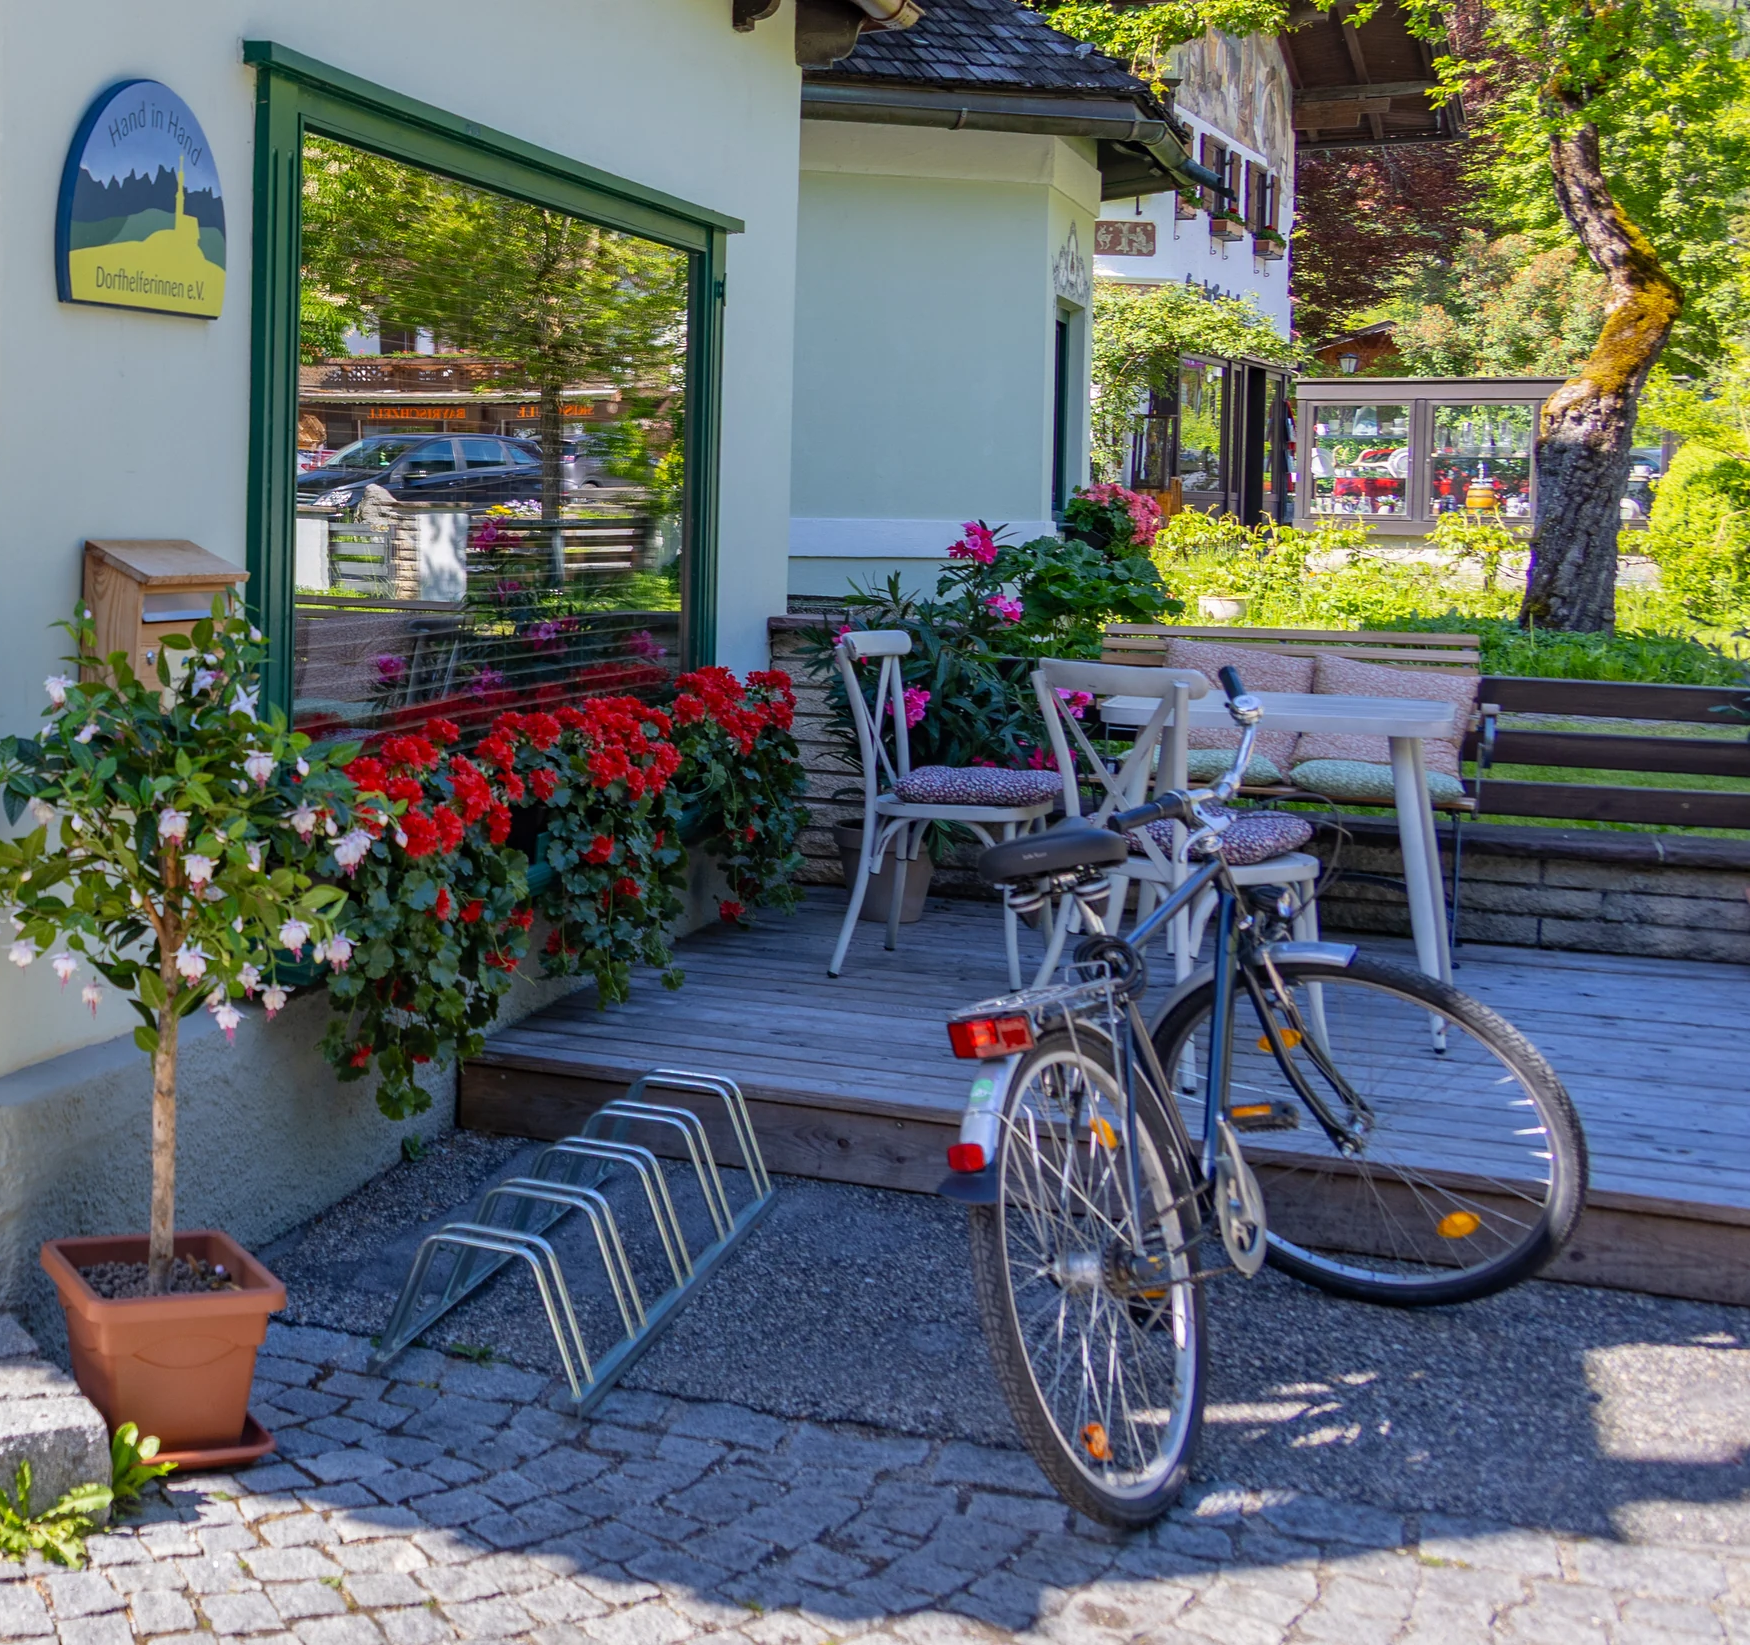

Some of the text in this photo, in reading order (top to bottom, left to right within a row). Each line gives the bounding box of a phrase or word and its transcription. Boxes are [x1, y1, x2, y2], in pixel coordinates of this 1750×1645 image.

[108, 100, 203, 167] Hand in Hand
[95, 265, 205, 301] Dorfhelferinnen e.V.
